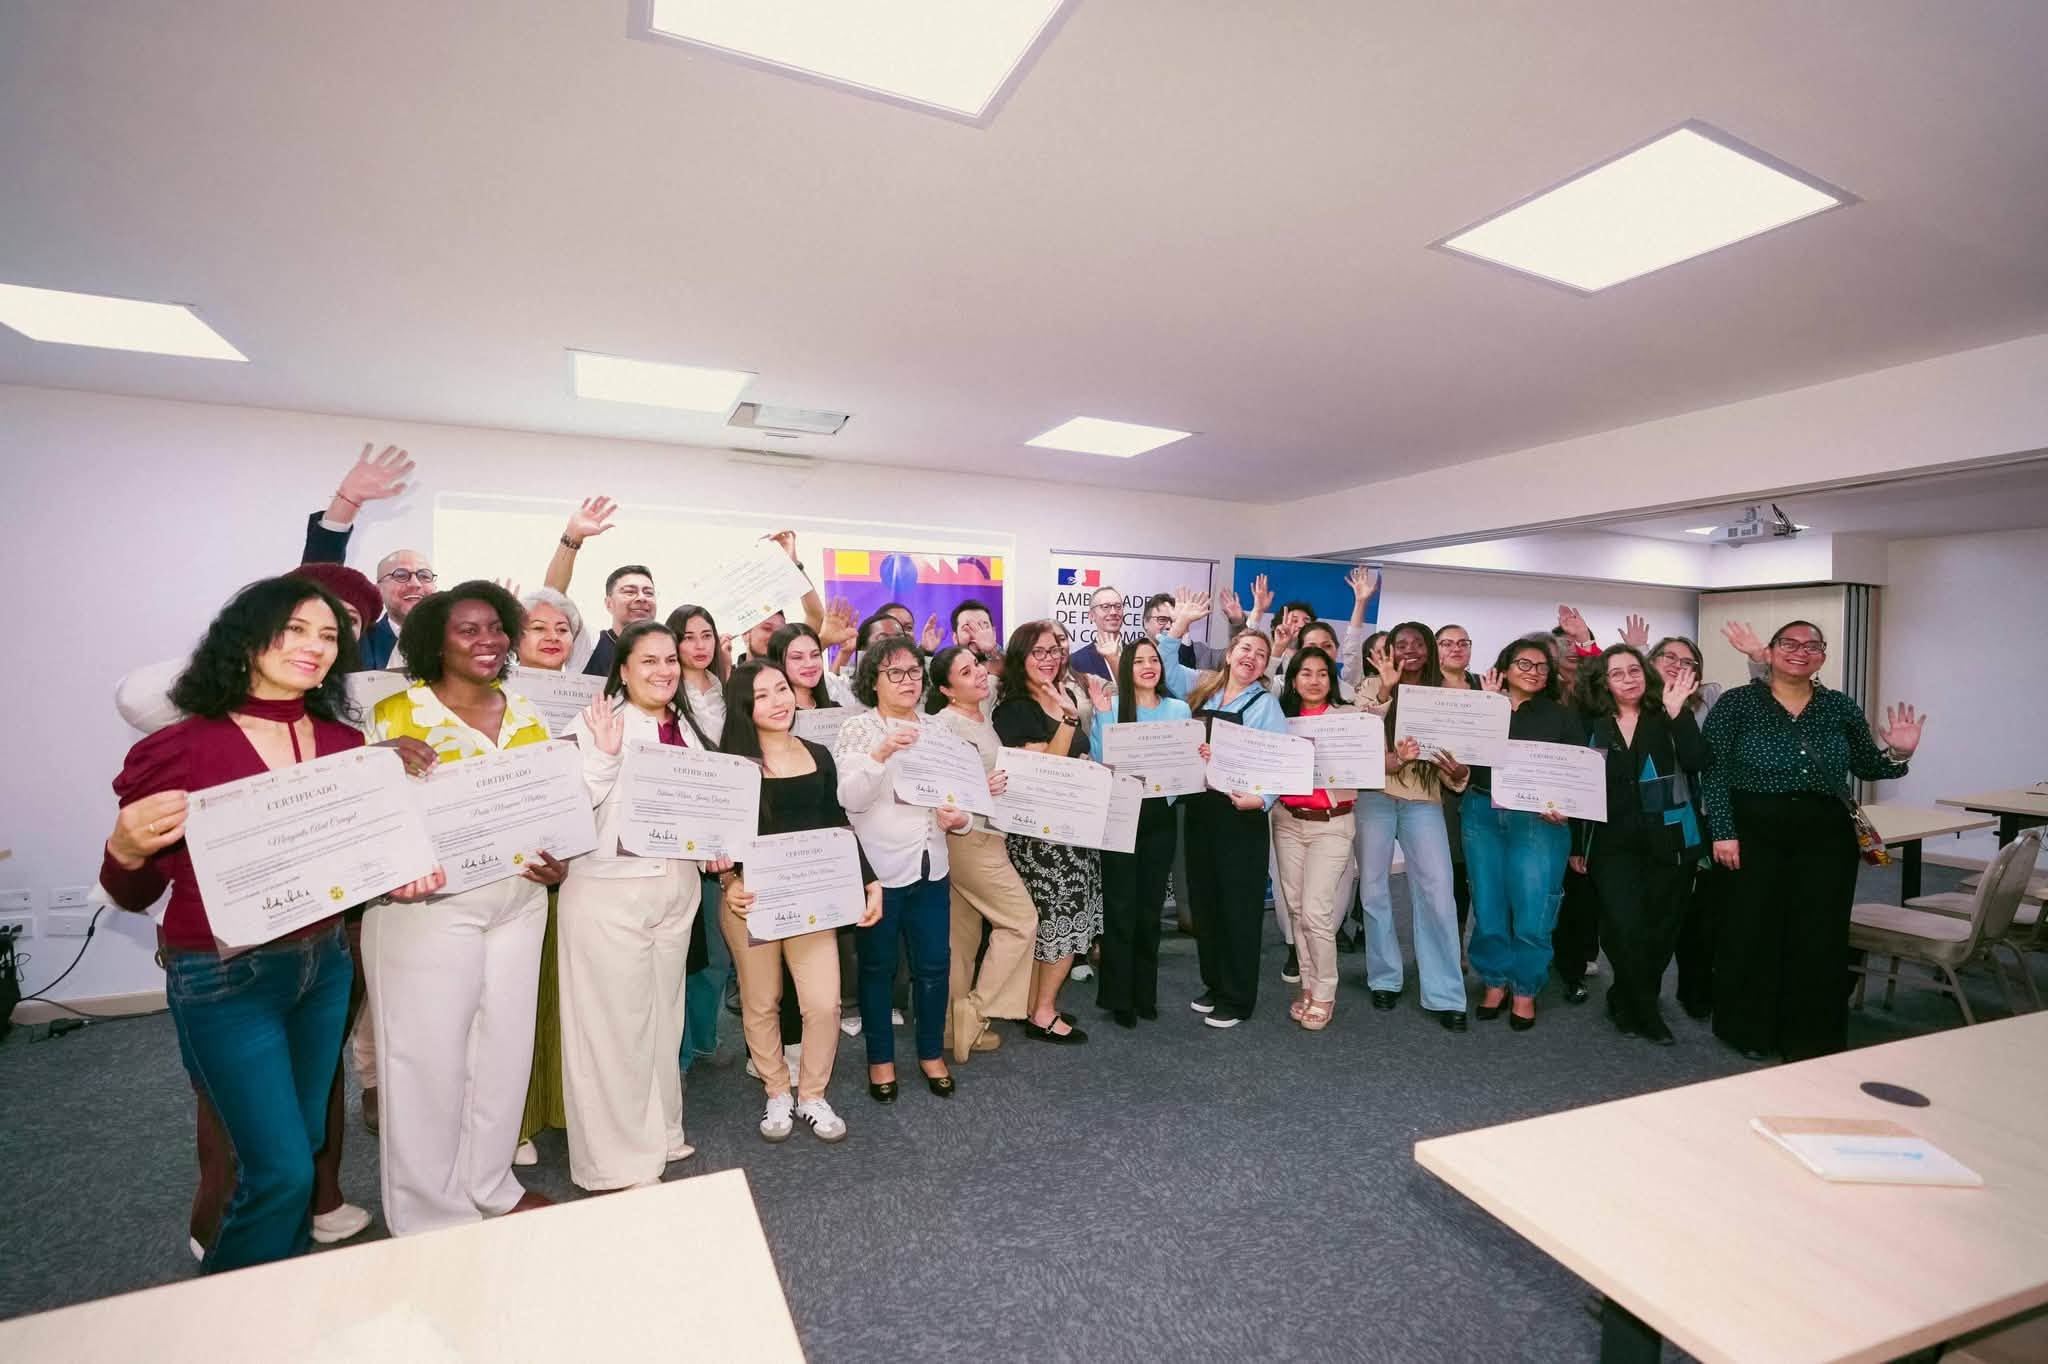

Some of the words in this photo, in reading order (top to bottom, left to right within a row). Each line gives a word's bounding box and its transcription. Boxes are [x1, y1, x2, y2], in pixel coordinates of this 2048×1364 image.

[1056, 610, 1077, 624] DE
[475, 767, 533, 788] CERTIFICADO
[266, 783, 338, 811] CERTIFICADO
